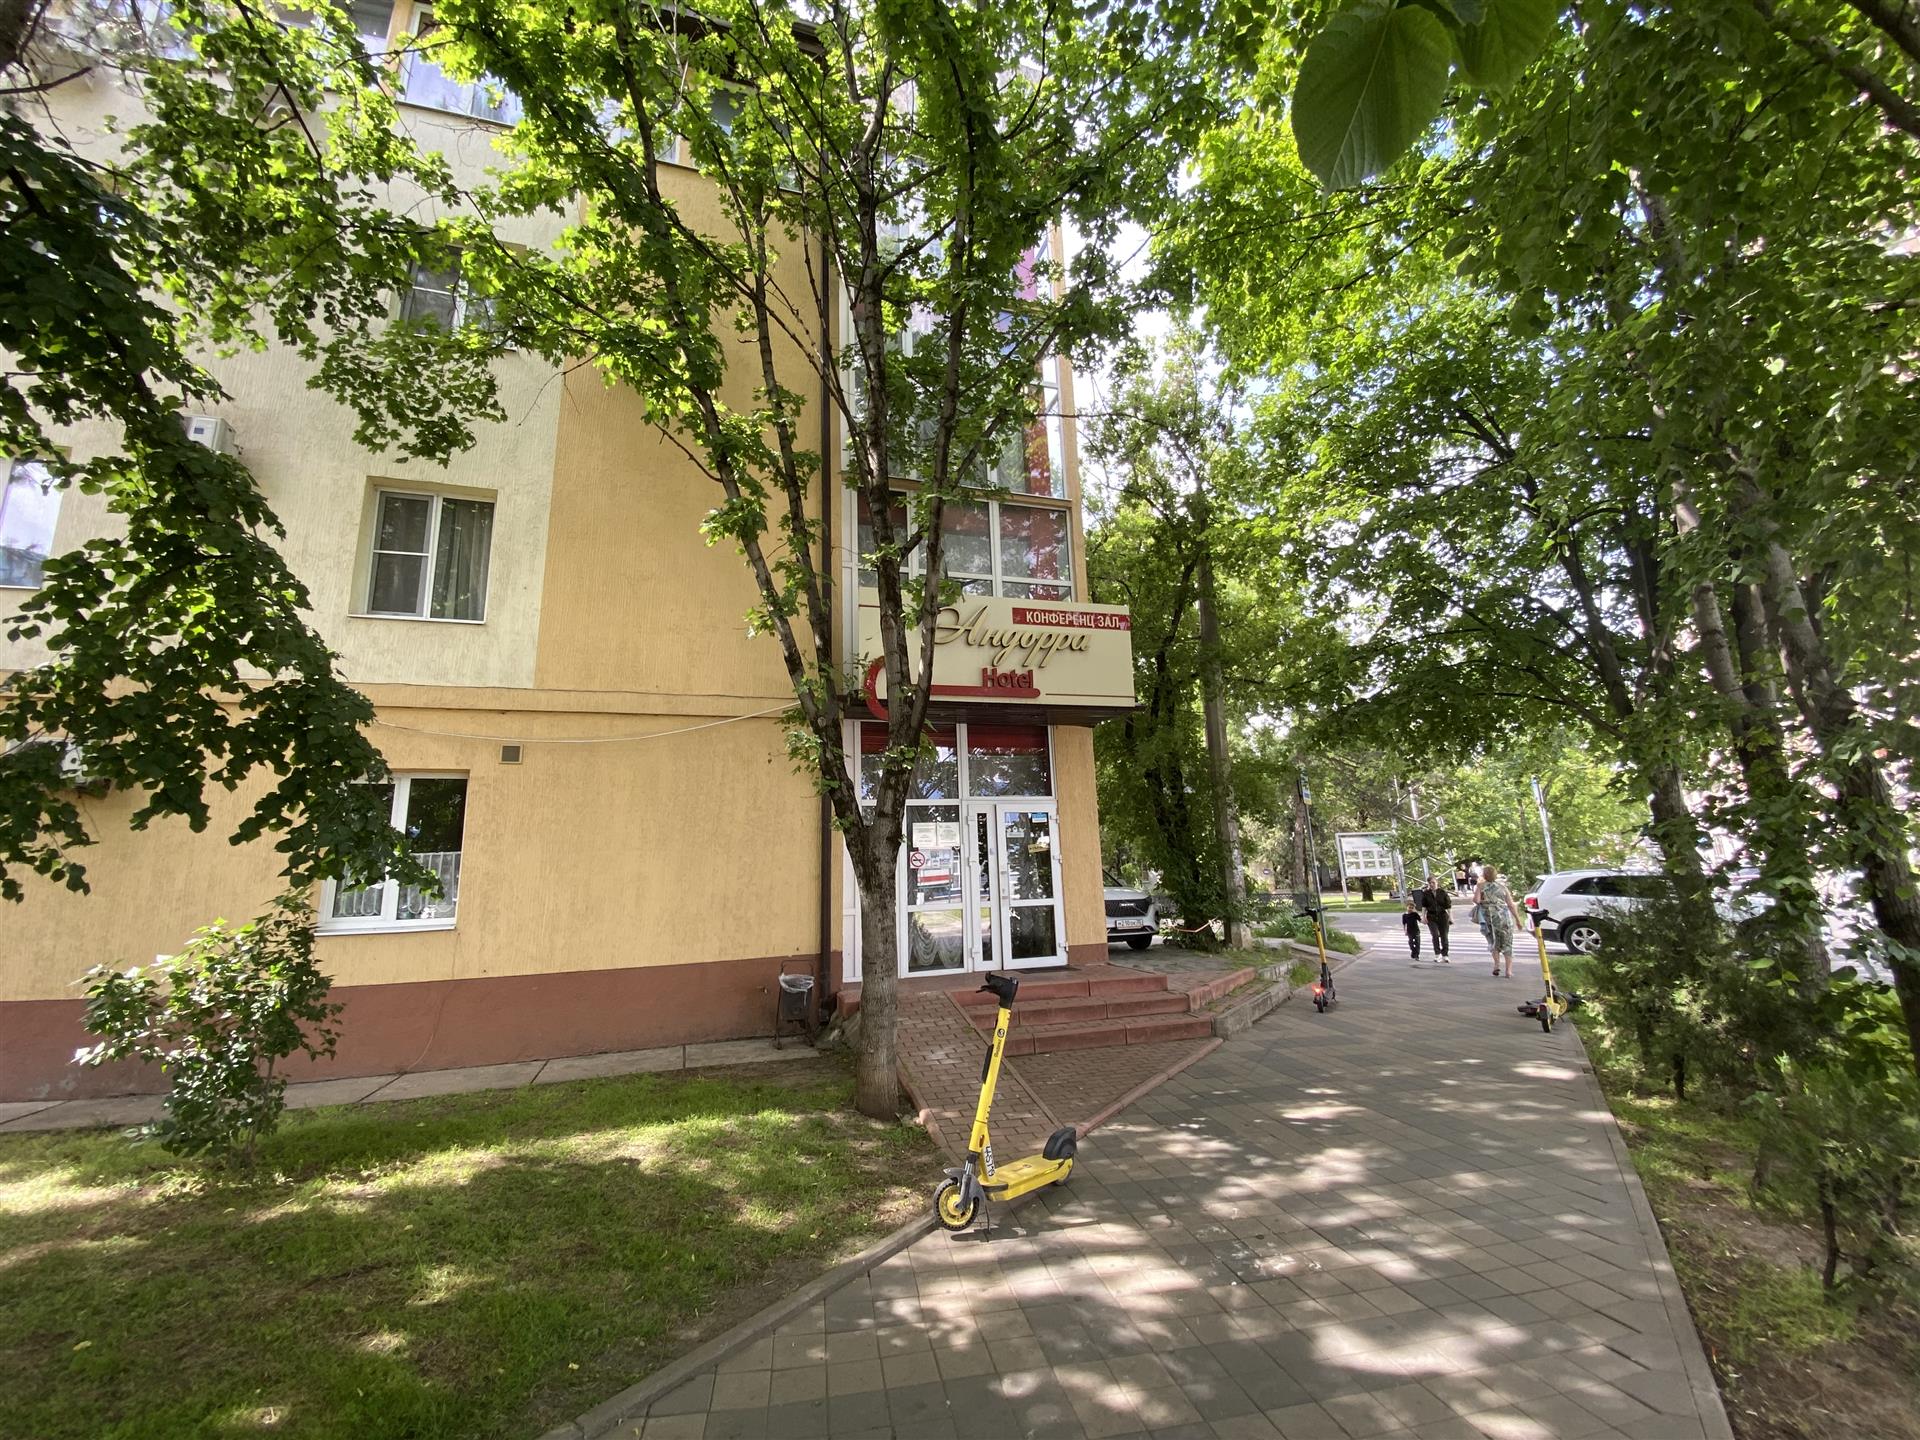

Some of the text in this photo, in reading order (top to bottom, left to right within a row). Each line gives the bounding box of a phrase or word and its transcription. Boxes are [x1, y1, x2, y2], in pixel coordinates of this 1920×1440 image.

[1025, 610, 1120, 629] КОНФЕРЕНЦ ЗАЛ
[934, 605, 1091, 668] Андорра
[981, 667, 1034, 690] Hotel
